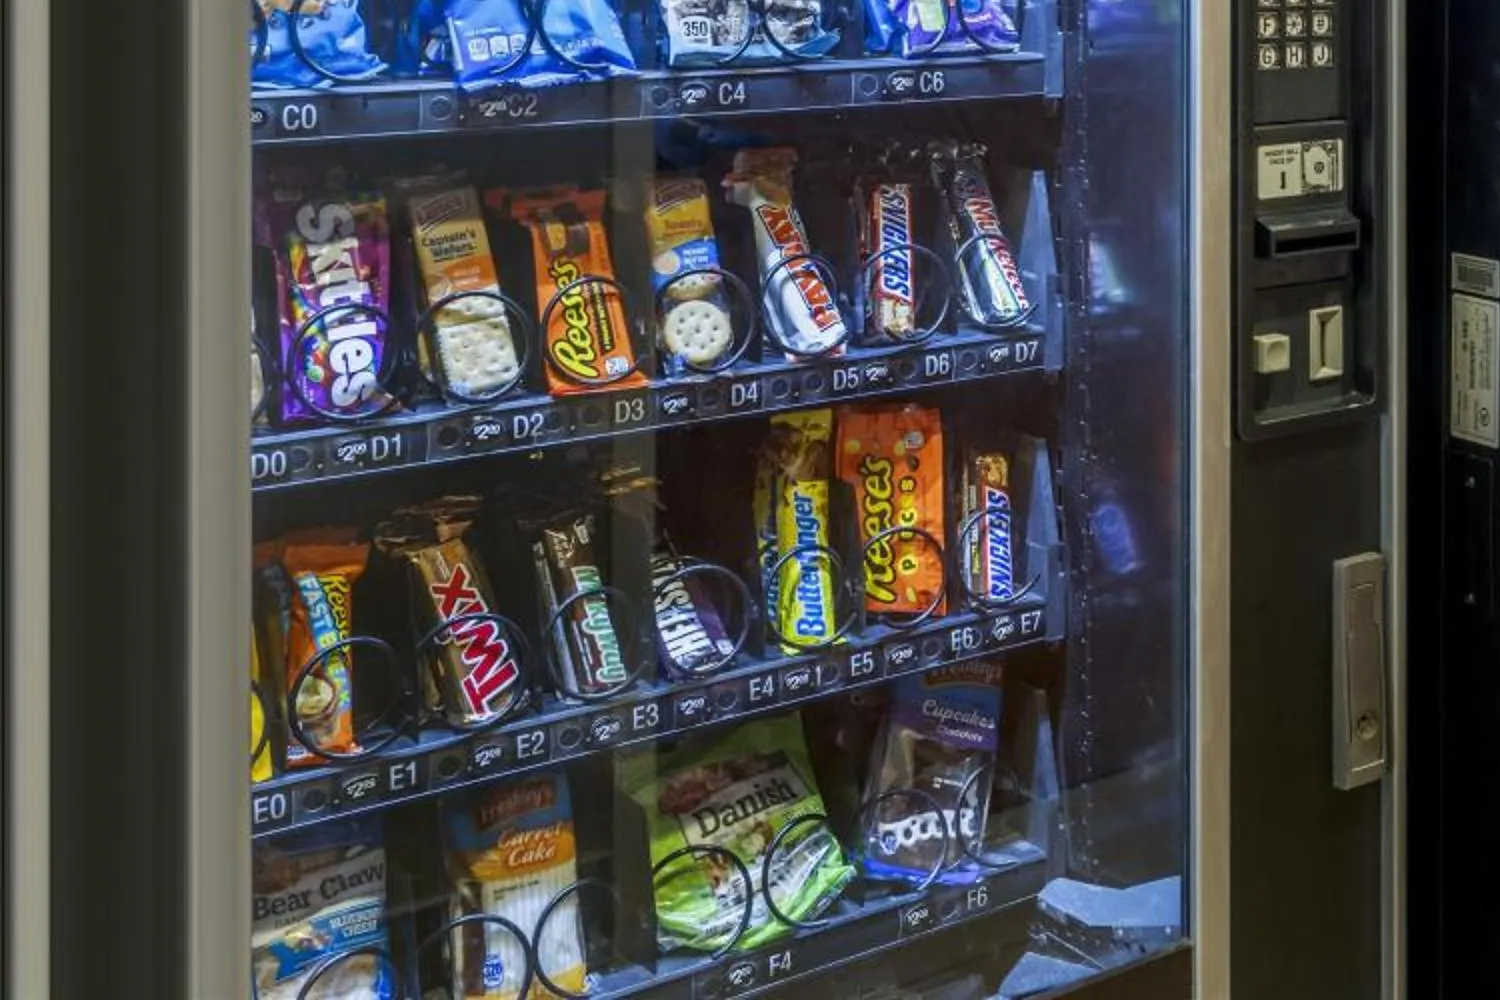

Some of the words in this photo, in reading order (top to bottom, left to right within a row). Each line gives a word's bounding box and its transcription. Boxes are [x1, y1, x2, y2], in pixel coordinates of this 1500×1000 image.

[682, 18, 710, 37] 350
[718, 81, 746, 106] C4
[918, 70, 946, 94] C6
[281, 104, 318, 130] C0
[421, 226, 477, 247] Captain's
[880, 184, 910, 298] SNICKERS
[551, 256, 600, 378] Reese's
[925, 352, 950, 376] D6
[1015, 341, 1039, 363] D7
[833, 366, 860, 391] D5
[732, 383, 758, 407] D4
[614, 400, 645, 423] D3
[513, 413, 543, 438] D2
[371, 435, 401, 458] D1
[251, 452, 286, 478] D0
[862, 455, 897, 603] Reese's
[986, 488, 1015, 598] SNICKERS
[1020, 610, 1042, 634] E7
[299, 576, 335, 631] FAST
[319, 632, 351, 708] BEAK
[430, 562, 520, 718] TWIX
[950, 627, 975, 651] E6
[850, 653, 875, 677] E5
[749, 676, 774, 701] E4
[633, 705, 660, 730] E3
[922, 698, 996, 729] Cupcakes
[516, 731, 545, 759] E2
[388, 762, 418, 790] E1
[253, 793, 286, 822] E0
[691, 777, 799, 839] Danish
[498, 821, 563, 849] Carrot
[508, 843, 556, 867] Cake
[252, 888, 312, 919] Bear
[319, 861, 384, 900] Claw
[966, 886, 988, 910] F6
[768, 951, 792, 977] F4
